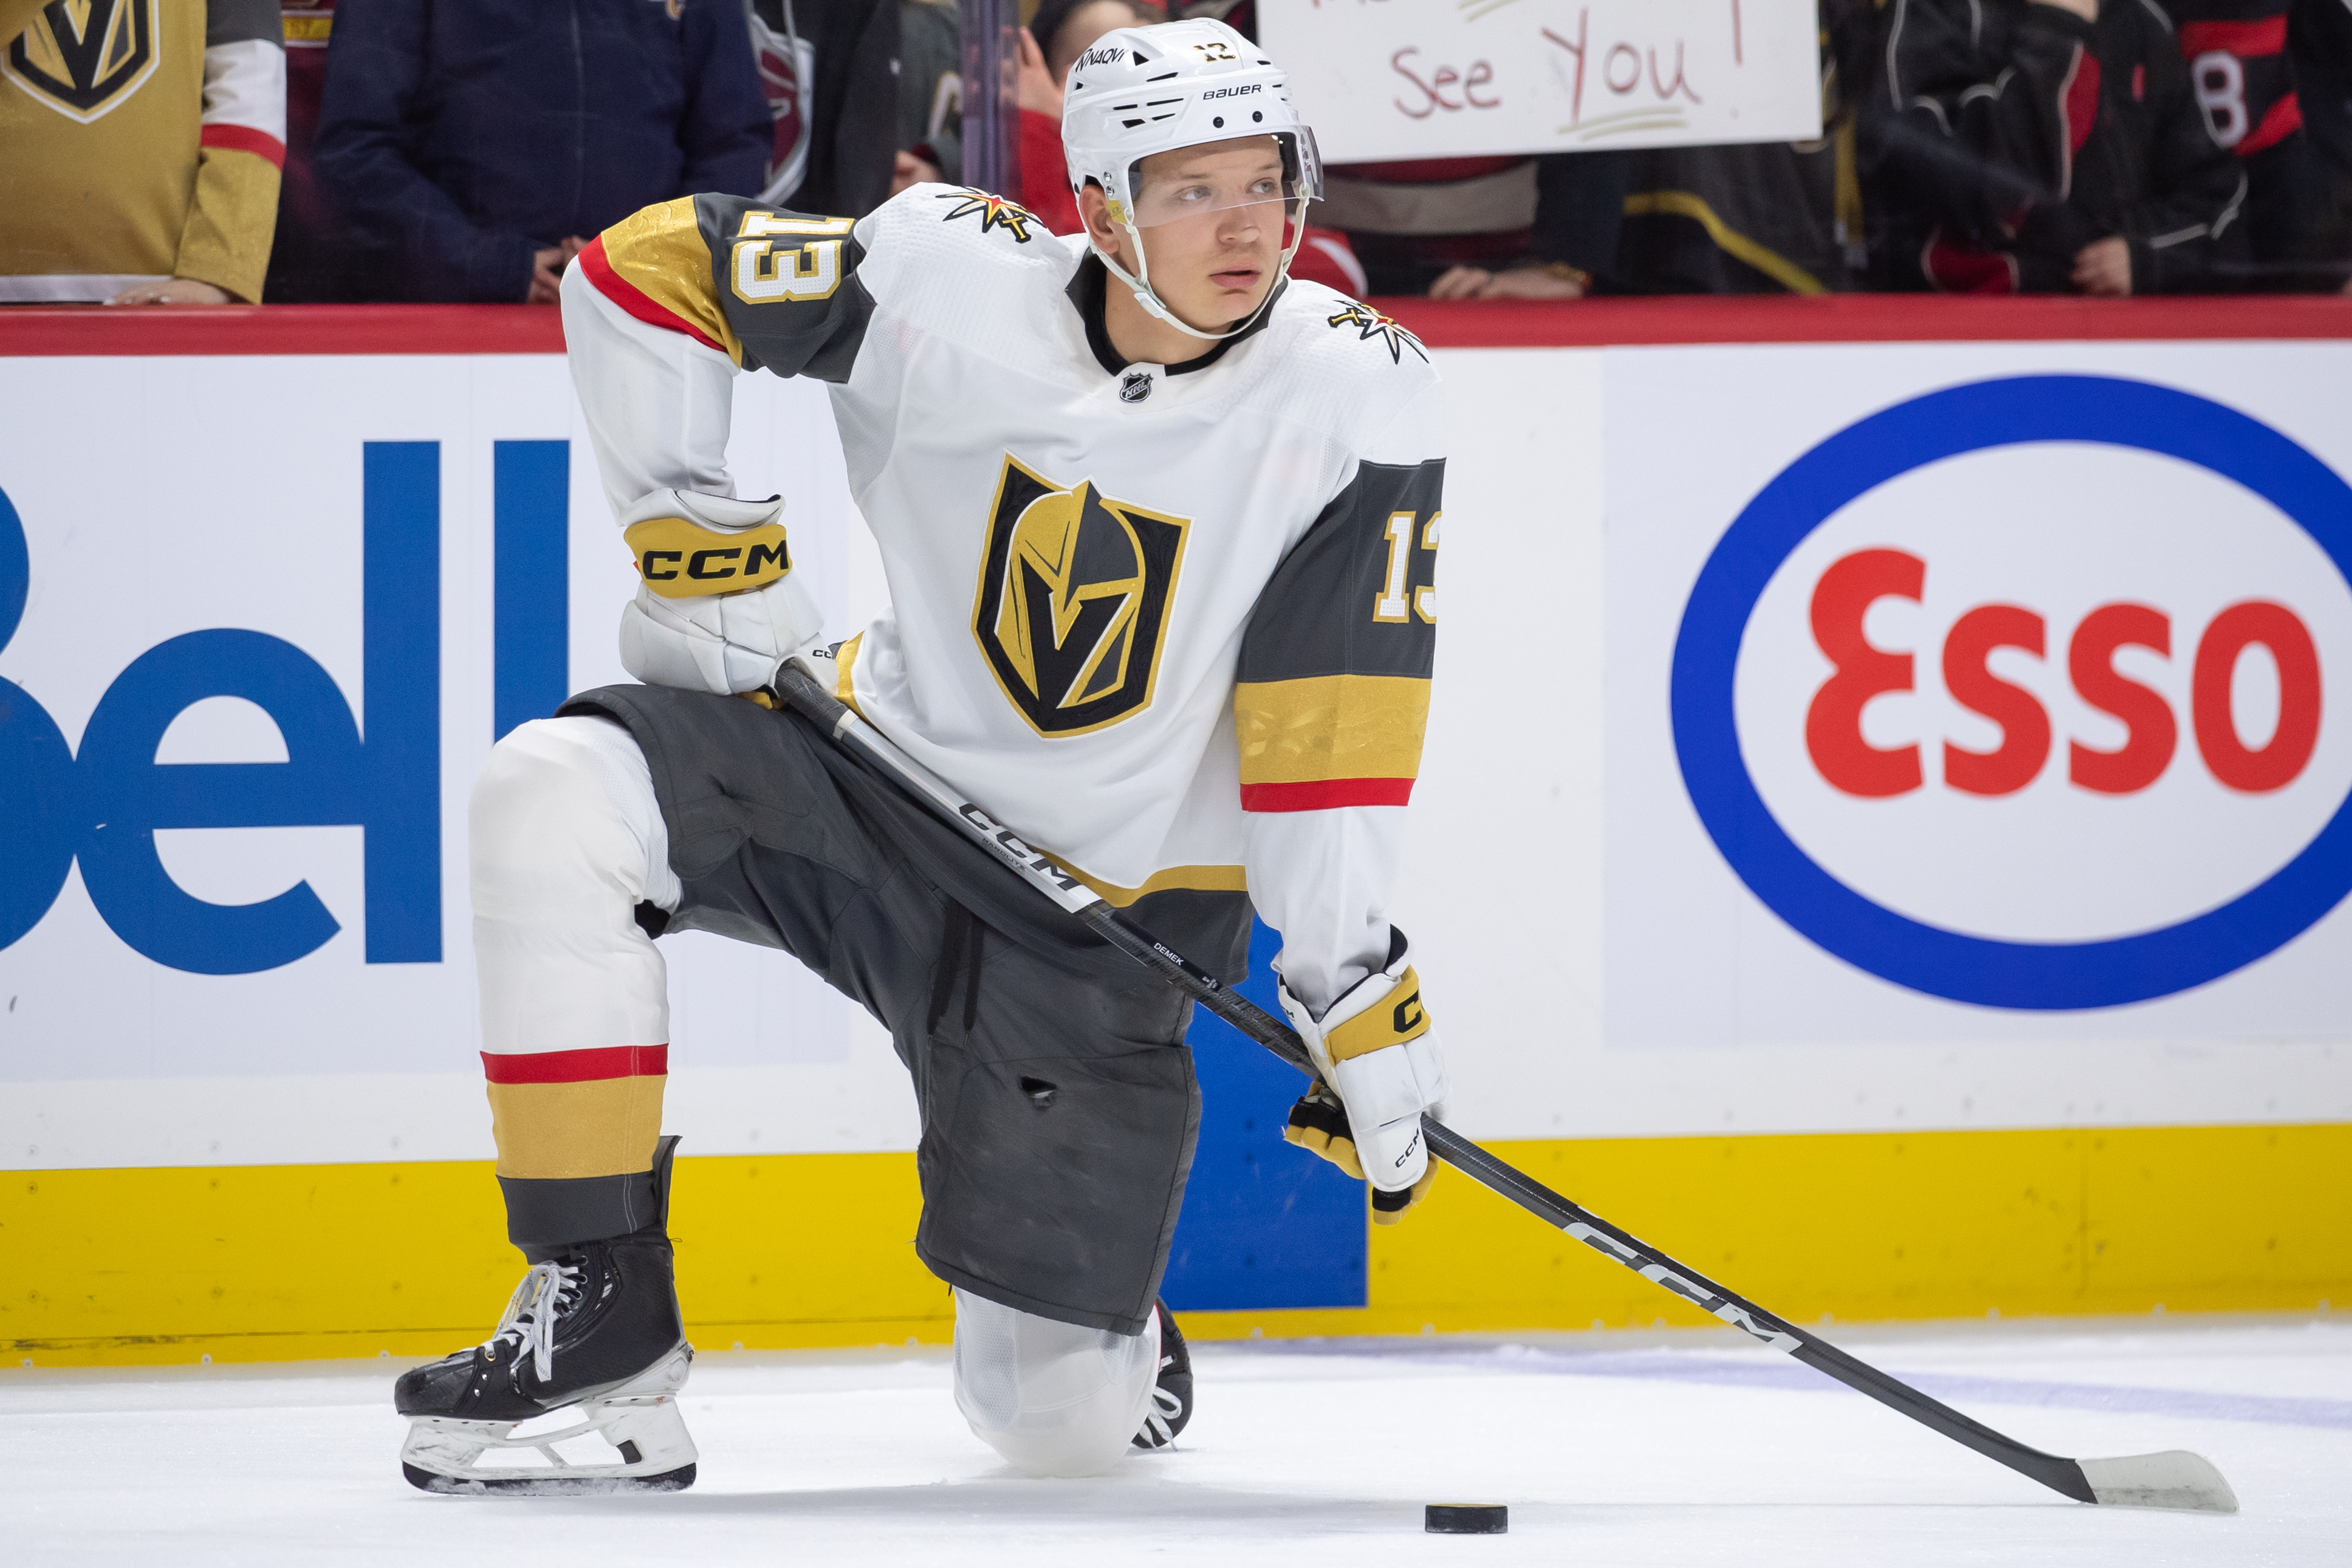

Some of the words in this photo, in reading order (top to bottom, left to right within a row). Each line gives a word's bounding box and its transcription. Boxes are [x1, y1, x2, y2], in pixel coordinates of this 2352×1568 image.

[1391, 46, 1501, 118] See
[1541, 9, 1702, 123] You
[731, 210, 855, 305] 13
[1125, 382, 1147, 398] NHL
[642, 539, 789, 580] CCM
[0, 437, 570, 976] ell
[959, 803, 1082, 891] CCM
[1154, 942, 1184, 966] DEMEK
[1395, 1127, 1419, 1168] CCM
